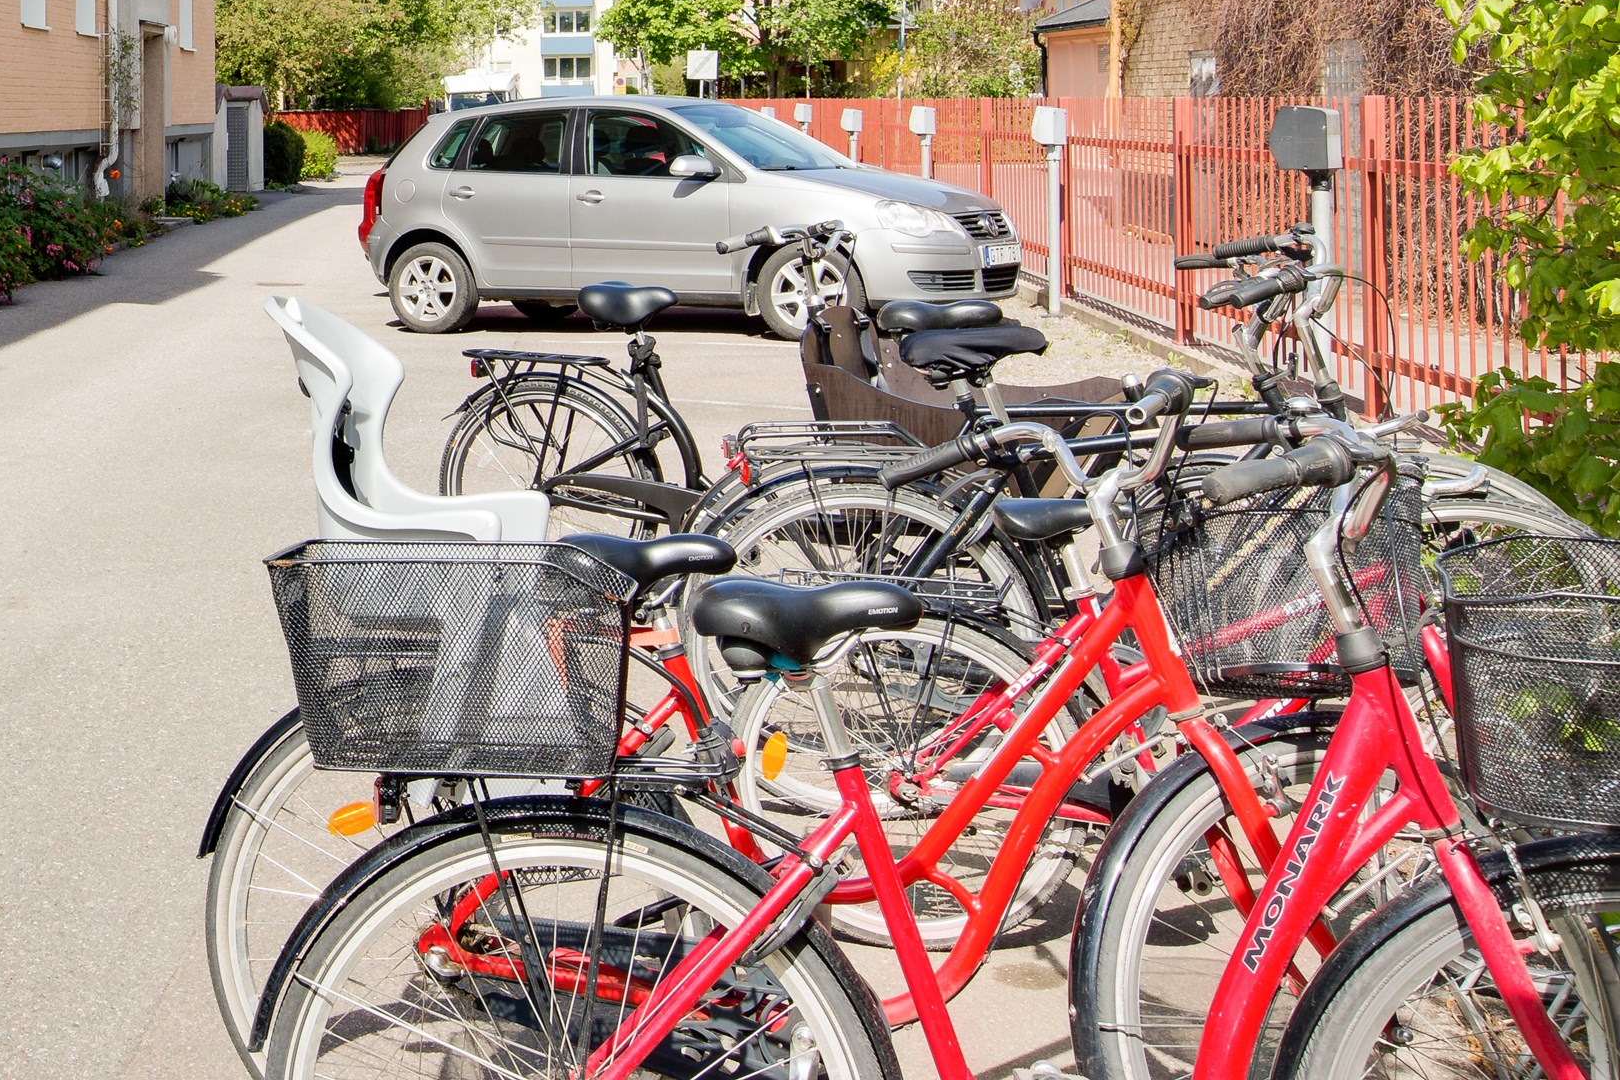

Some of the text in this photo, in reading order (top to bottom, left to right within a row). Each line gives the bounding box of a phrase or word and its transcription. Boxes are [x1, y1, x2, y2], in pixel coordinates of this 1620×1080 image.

[990, 247, 1005, 263] GTF
[868, 606, 899, 616] EMOTION
[1004, 660, 1048, 699] DBS
[1241, 770, 1347, 975] MONARK
